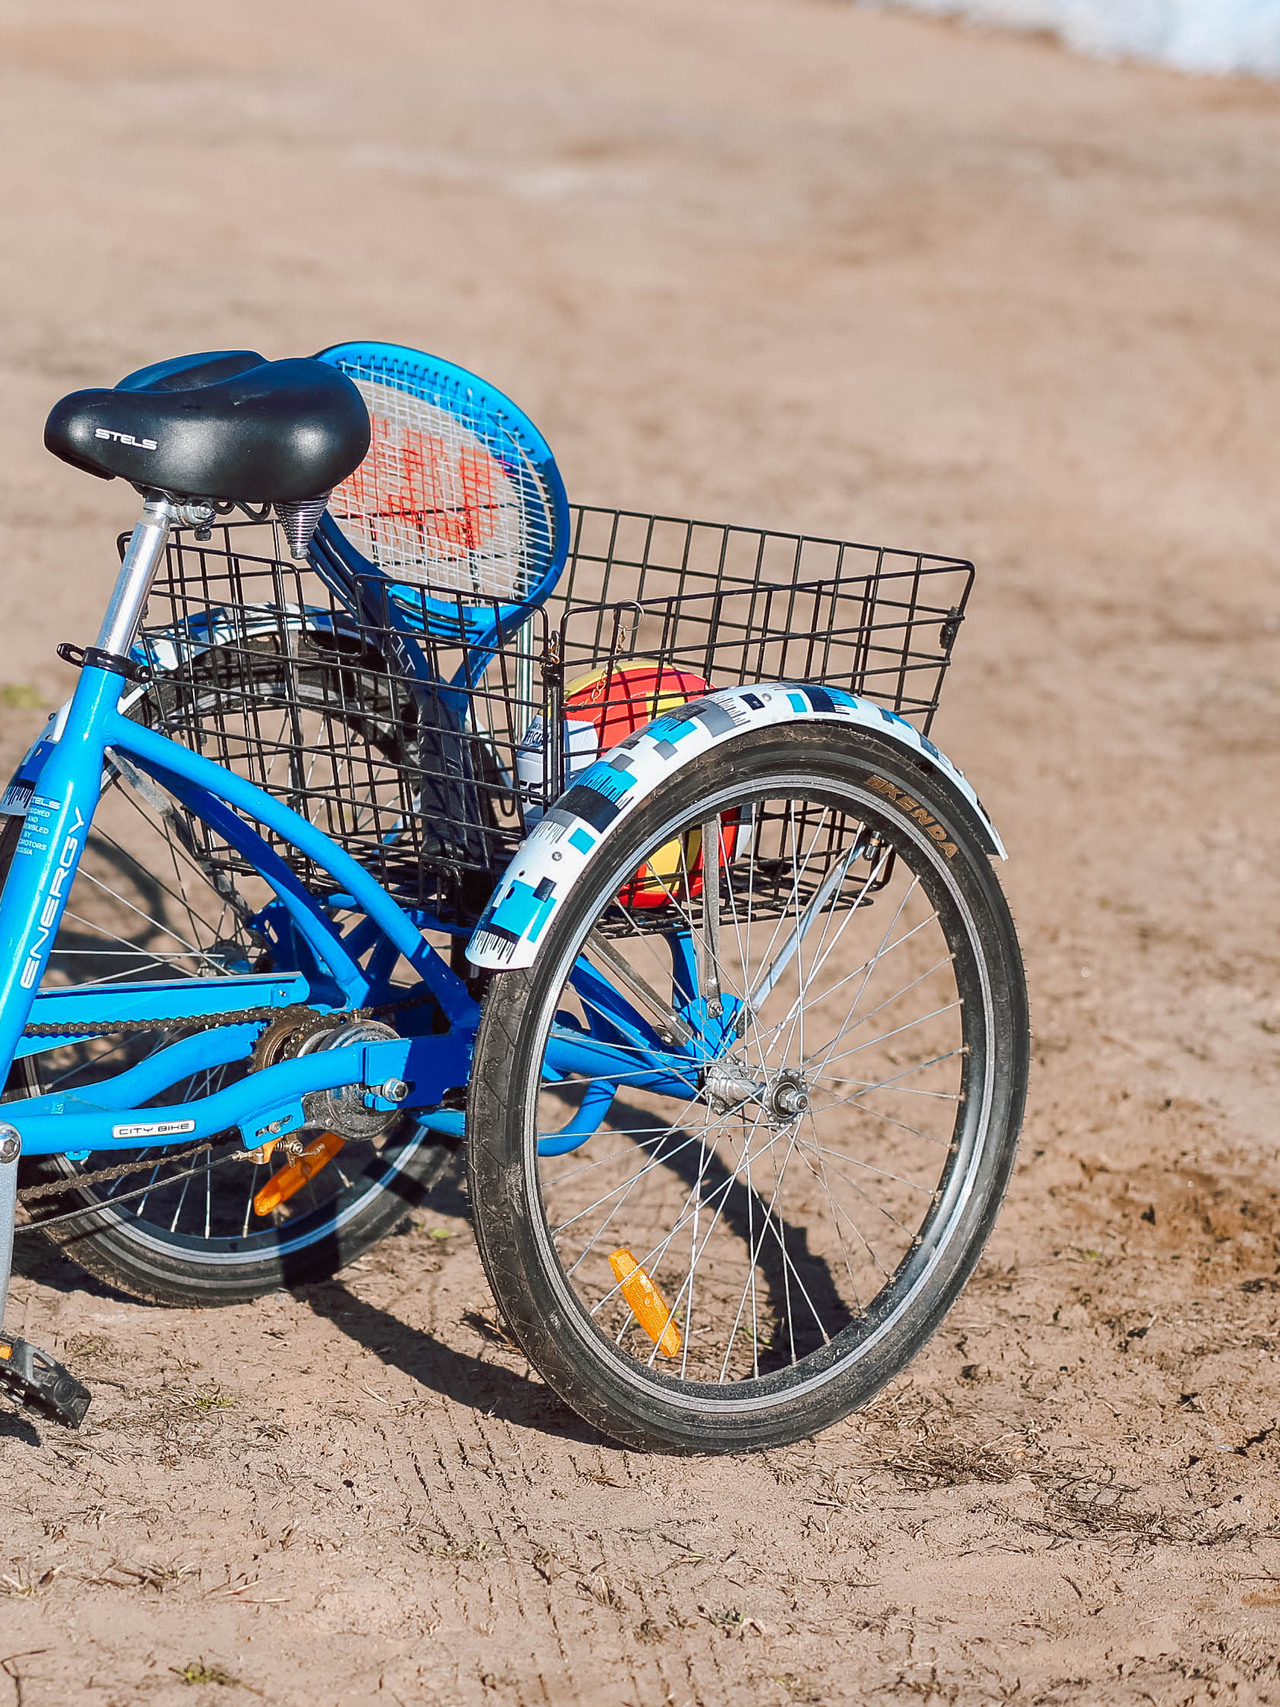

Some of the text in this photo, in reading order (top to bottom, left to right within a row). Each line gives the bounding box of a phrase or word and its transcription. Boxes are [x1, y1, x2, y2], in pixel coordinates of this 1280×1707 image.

[94, 427, 158, 451] STELS
[31, 796, 62, 810] TELS
[878, 782, 960, 859] KENDA
[19, 806, 86, 990] ENERGY
[119, 1123, 190, 1136] CITY BIKE
